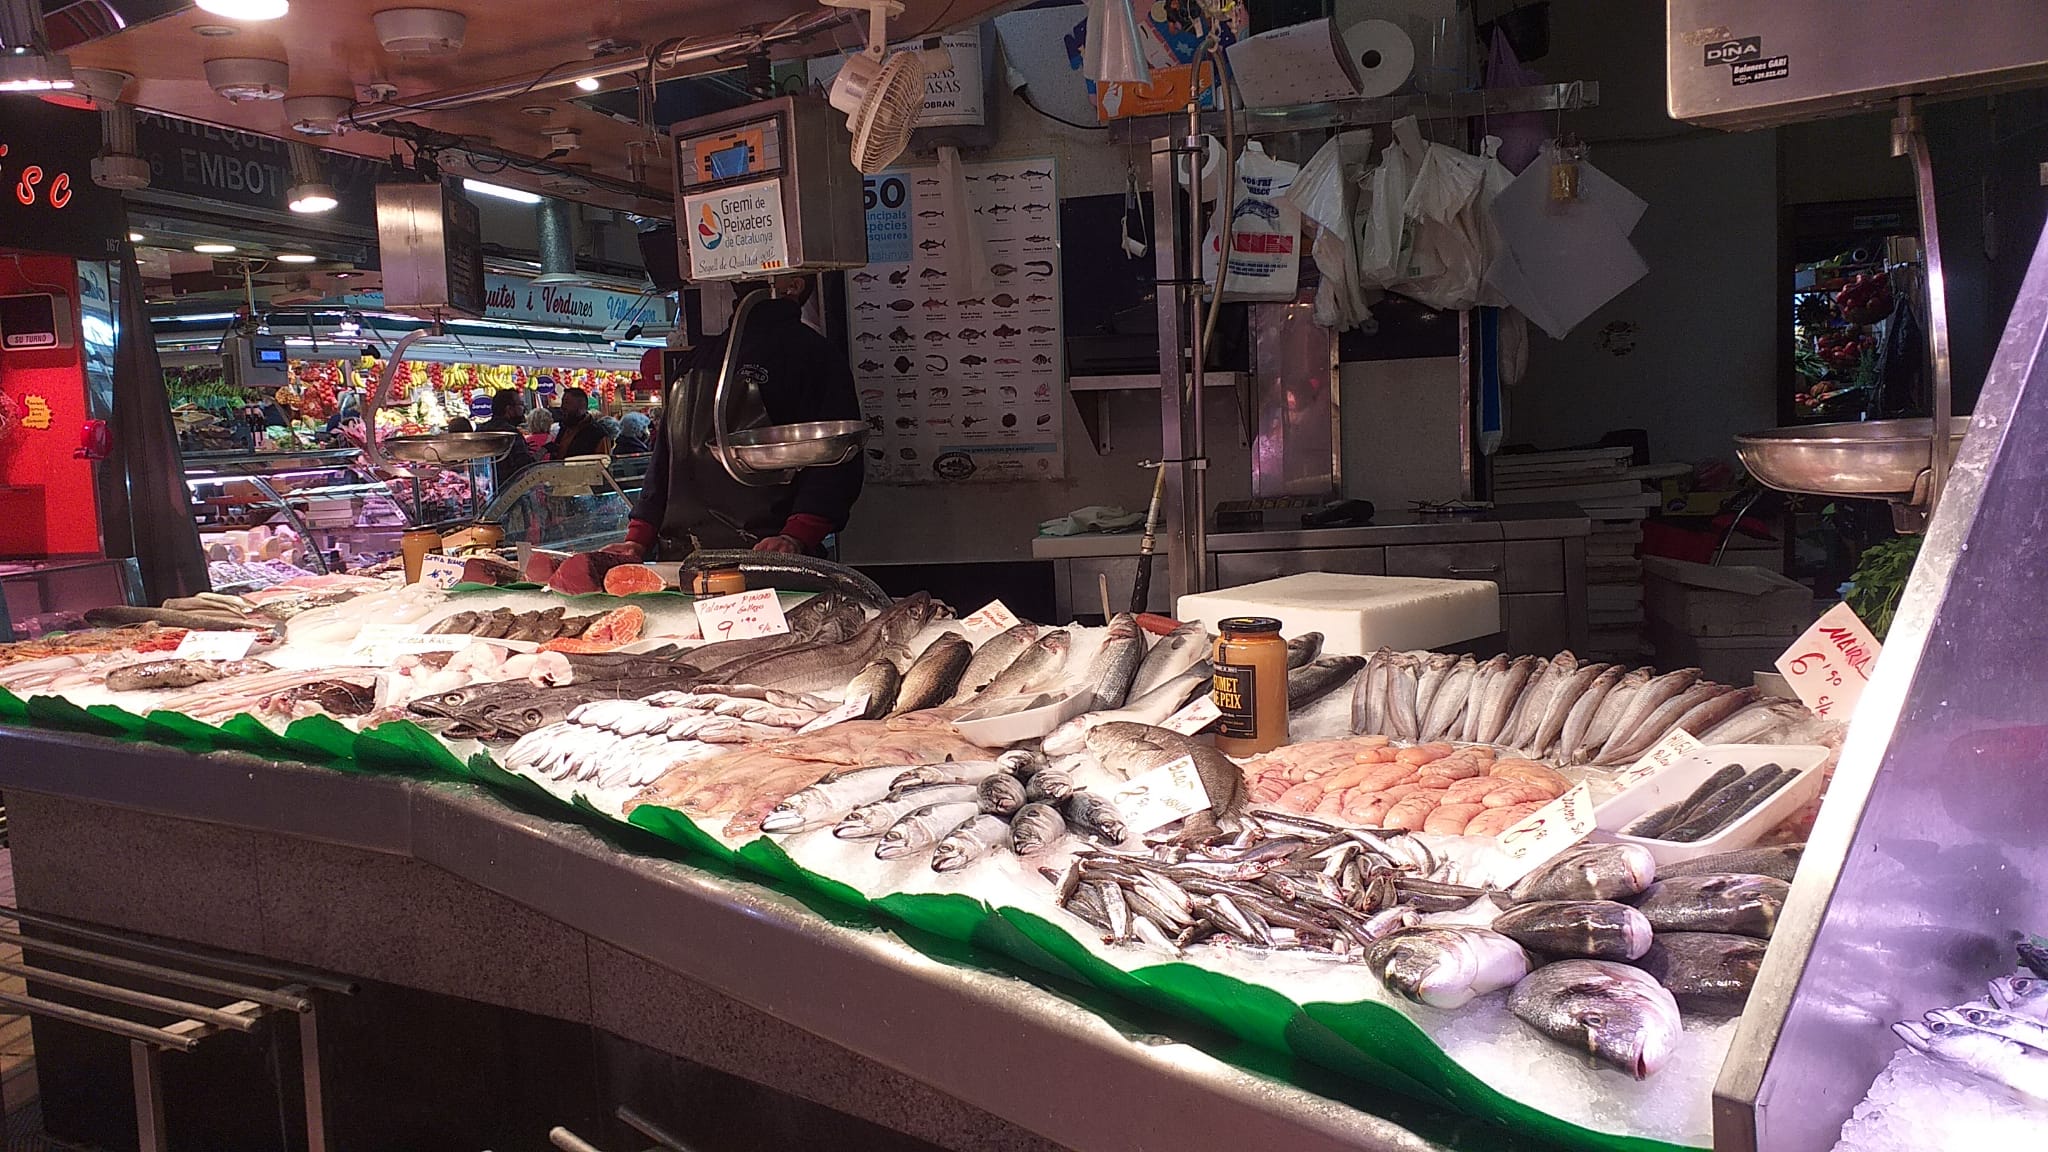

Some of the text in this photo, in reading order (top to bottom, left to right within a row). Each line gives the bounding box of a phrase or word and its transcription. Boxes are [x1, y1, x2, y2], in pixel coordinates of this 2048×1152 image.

[1707, 44, 1757, 59] DINA
[924, 100, 955, 109] OBRAN
[721, 194, 766, 215] Gremi de
[723, 214, 773, 233] Peixaters
[106, 238, 120, 252] 167
[725, 231, 773, 248] de Catalunya
[484, 284, 516, 310] uites
[526, 291, 534, 312] i
[542, 286, 593, 317] Verdures
[15, 334, 47, 343] SU TURNO
[1220, 692, 1242, 709] PEIX
